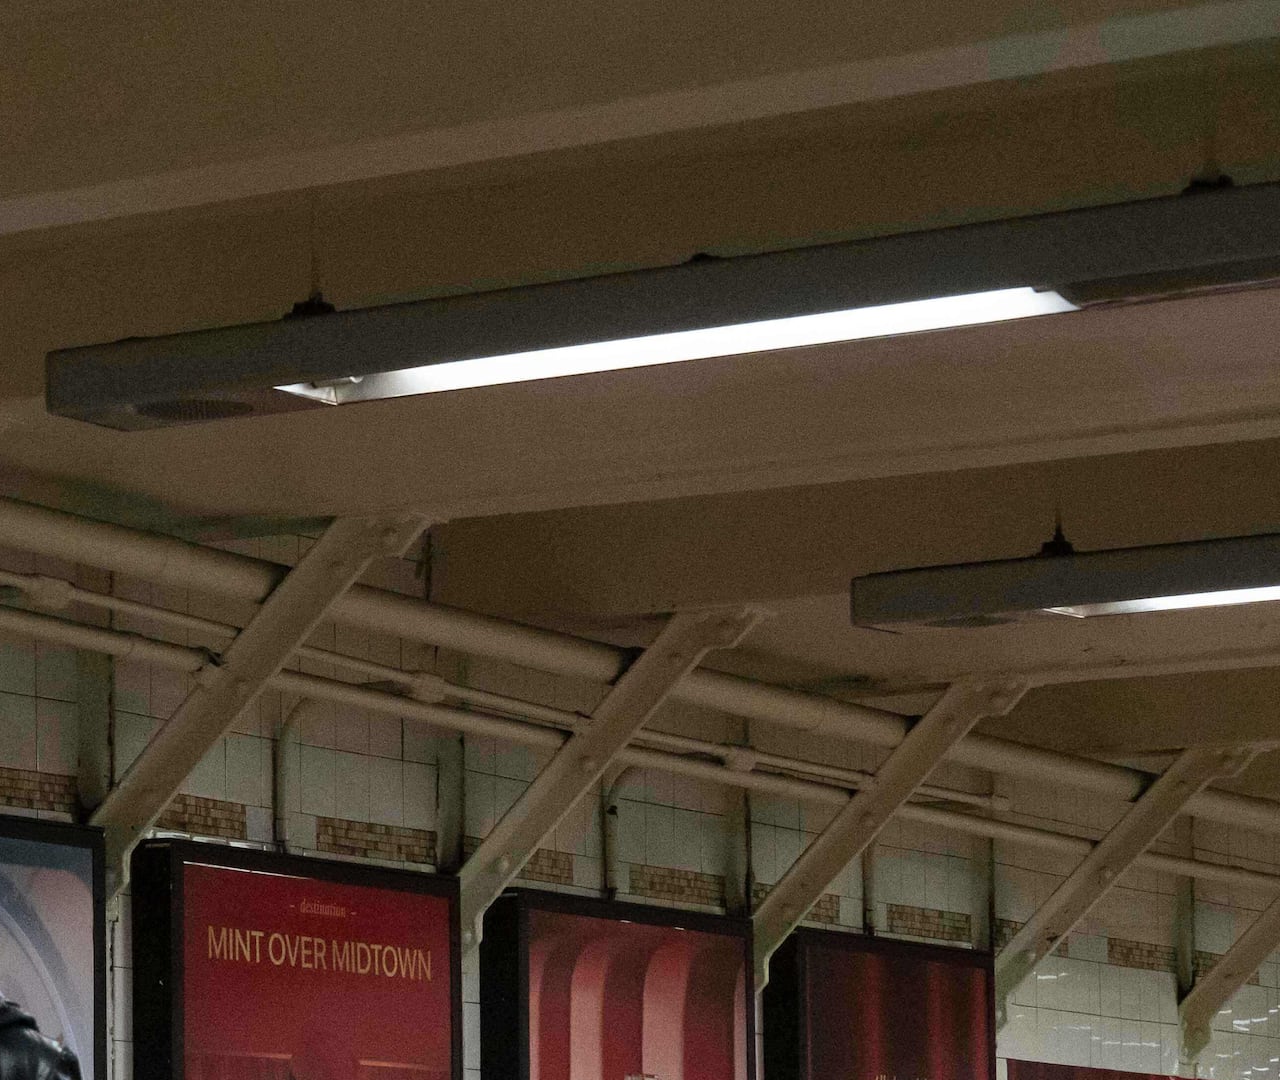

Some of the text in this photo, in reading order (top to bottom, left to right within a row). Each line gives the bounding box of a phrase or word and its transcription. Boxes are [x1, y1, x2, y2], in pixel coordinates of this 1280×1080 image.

[207, 925, 432, 981] MINT OVER MIDTOWN
